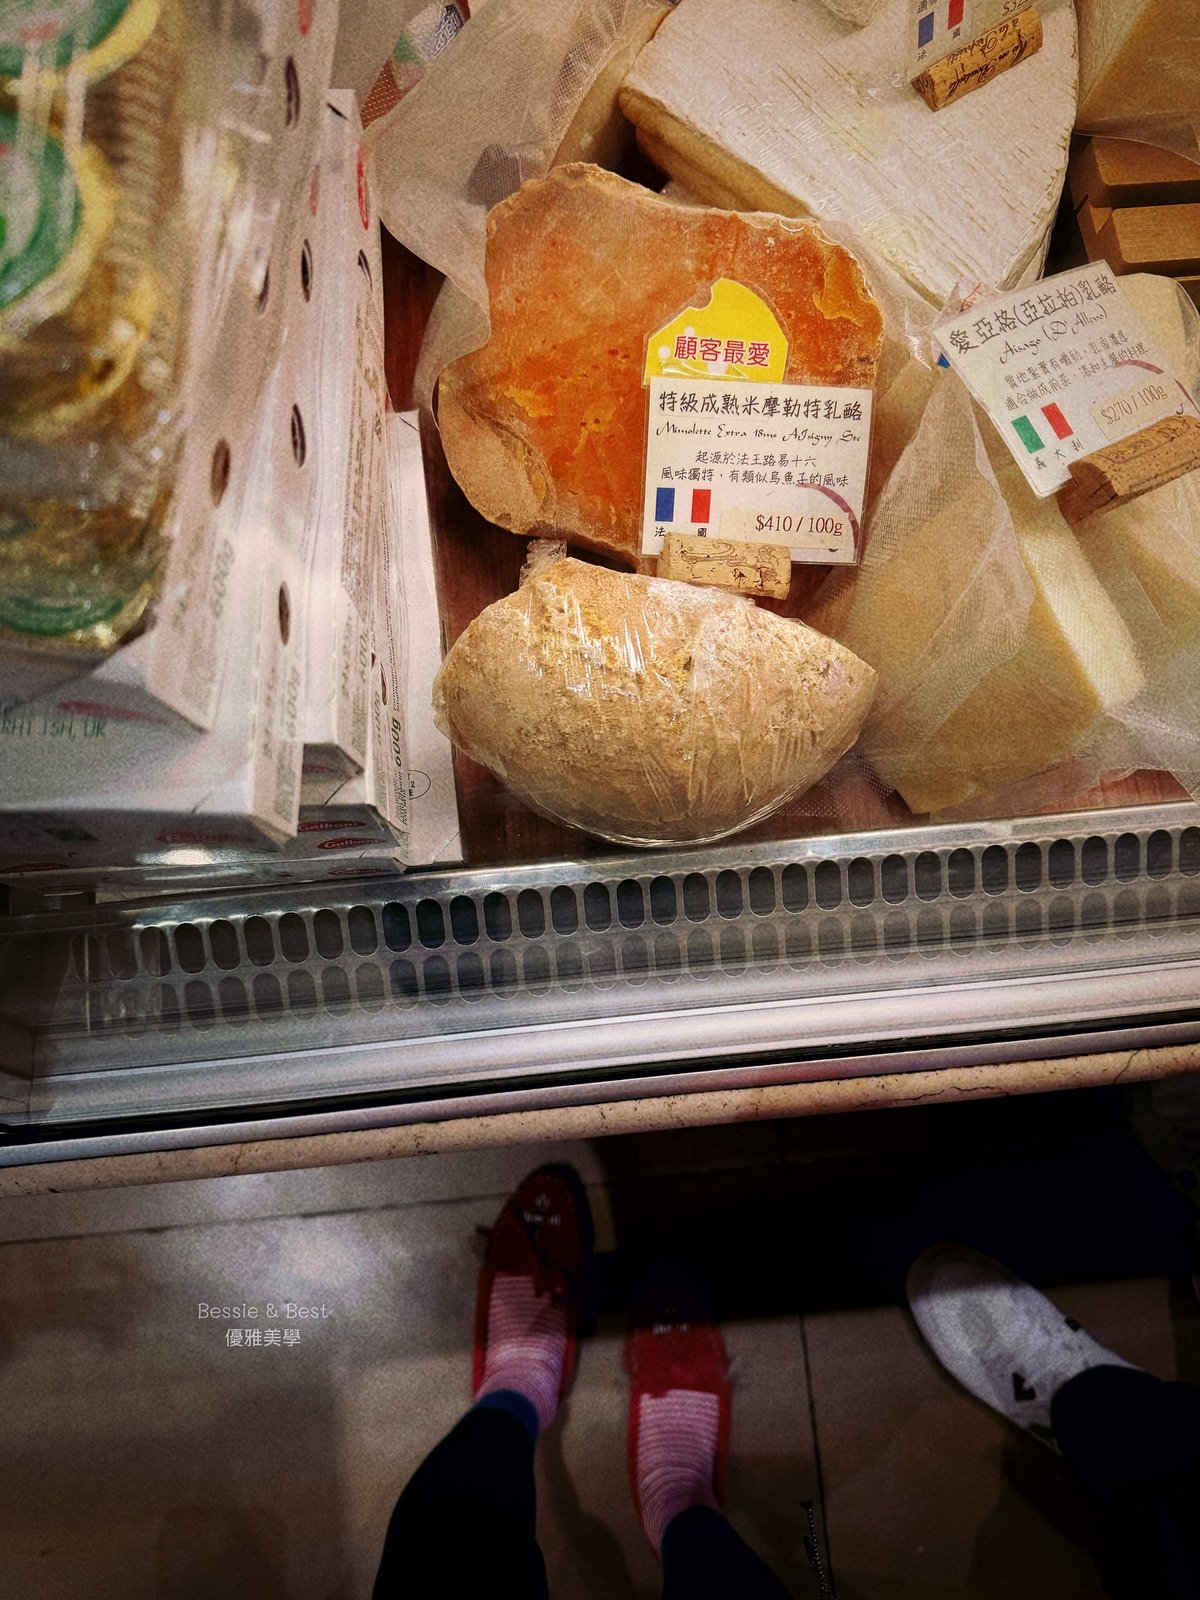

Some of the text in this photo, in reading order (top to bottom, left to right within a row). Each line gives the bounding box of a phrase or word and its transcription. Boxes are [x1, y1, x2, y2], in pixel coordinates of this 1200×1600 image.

[674, 335, 770, 367] 顧客最愛
[659, 390, 863, 421] 特級成熟米摩勒特乳酪
[1100, 395, 1132, 425] $270
[1141, 384, 1168, 407] 100g
[656, 421, 712, 436] Mimolette
[717, 423, 747, 439] Extra
[695, 451, 817, 468] 起源於法王路易十六
[1053, 448, 1066, 460] 大
[654, 526, 666, 537] 法
[755, 514, 792, 532] $410
[808, 516, 844, 536] 100g
[391, 718, 401, 768] 600g
